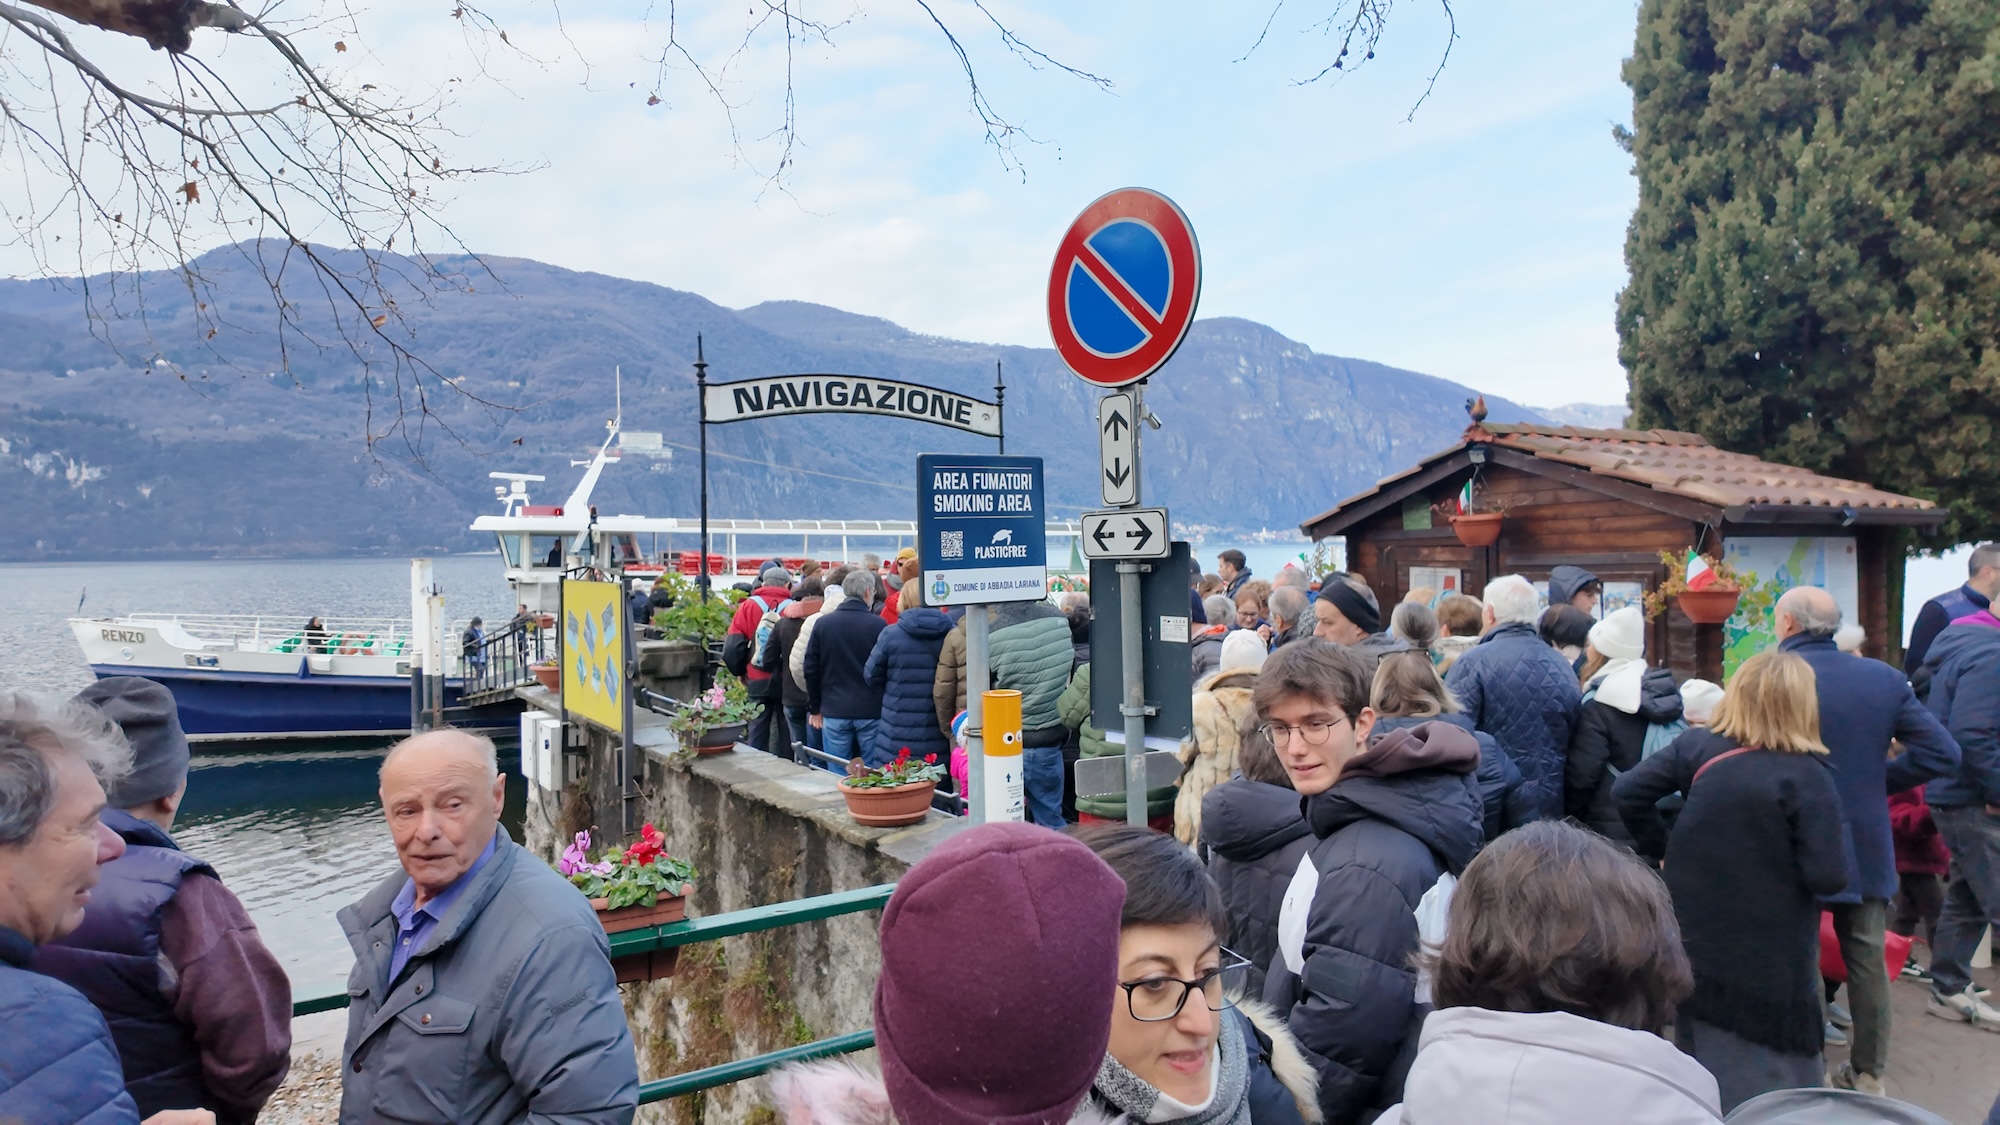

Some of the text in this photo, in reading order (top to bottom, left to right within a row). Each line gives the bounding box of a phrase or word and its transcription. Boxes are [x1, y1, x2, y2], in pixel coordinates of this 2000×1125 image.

[733, 381, 973, 425] NAVIGAZIONE
[933, 473, 1032, 490] AREA FUMATORI
[934, 494, 1032, 513] SMOKING AREA
[975, 545, 1027, 559] PLASTICFREE
[954, 580, 1040, 592] COMUNE DI ABBADIA LARIANA
[102, 629, 143, 643] RENZO
